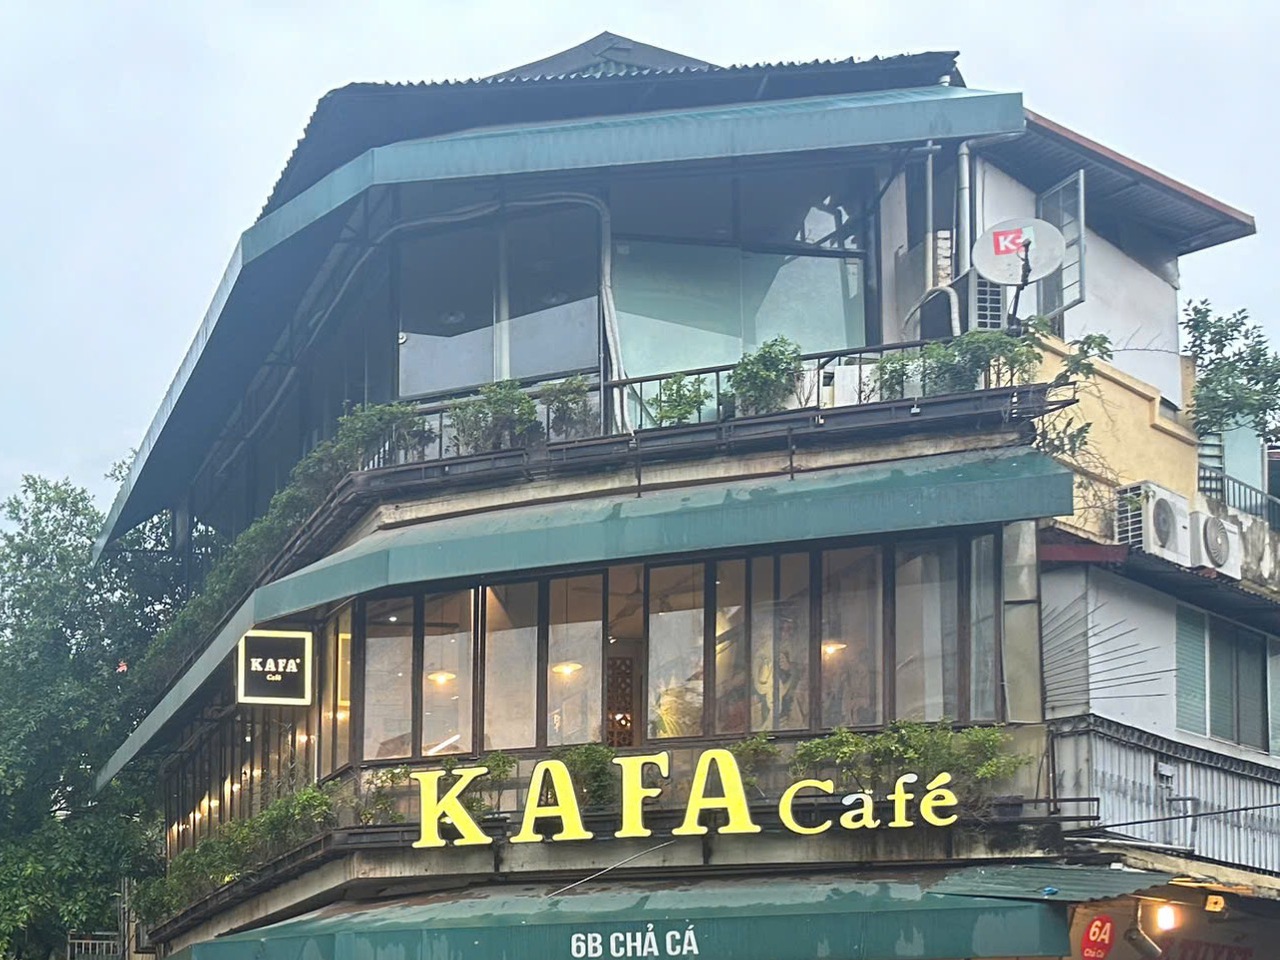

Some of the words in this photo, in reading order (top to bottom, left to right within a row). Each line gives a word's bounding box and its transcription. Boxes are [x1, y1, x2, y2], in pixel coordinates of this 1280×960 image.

[409, 748, 762, 849] KAFA
[778, 772, 959, 836] Café
[571, 932, 603, 958] 6B
[609, 923, 660, 958] CHẢ
[665, 924, 700, 956] CÁ
[1089, 920, 1111, 944] 6A
